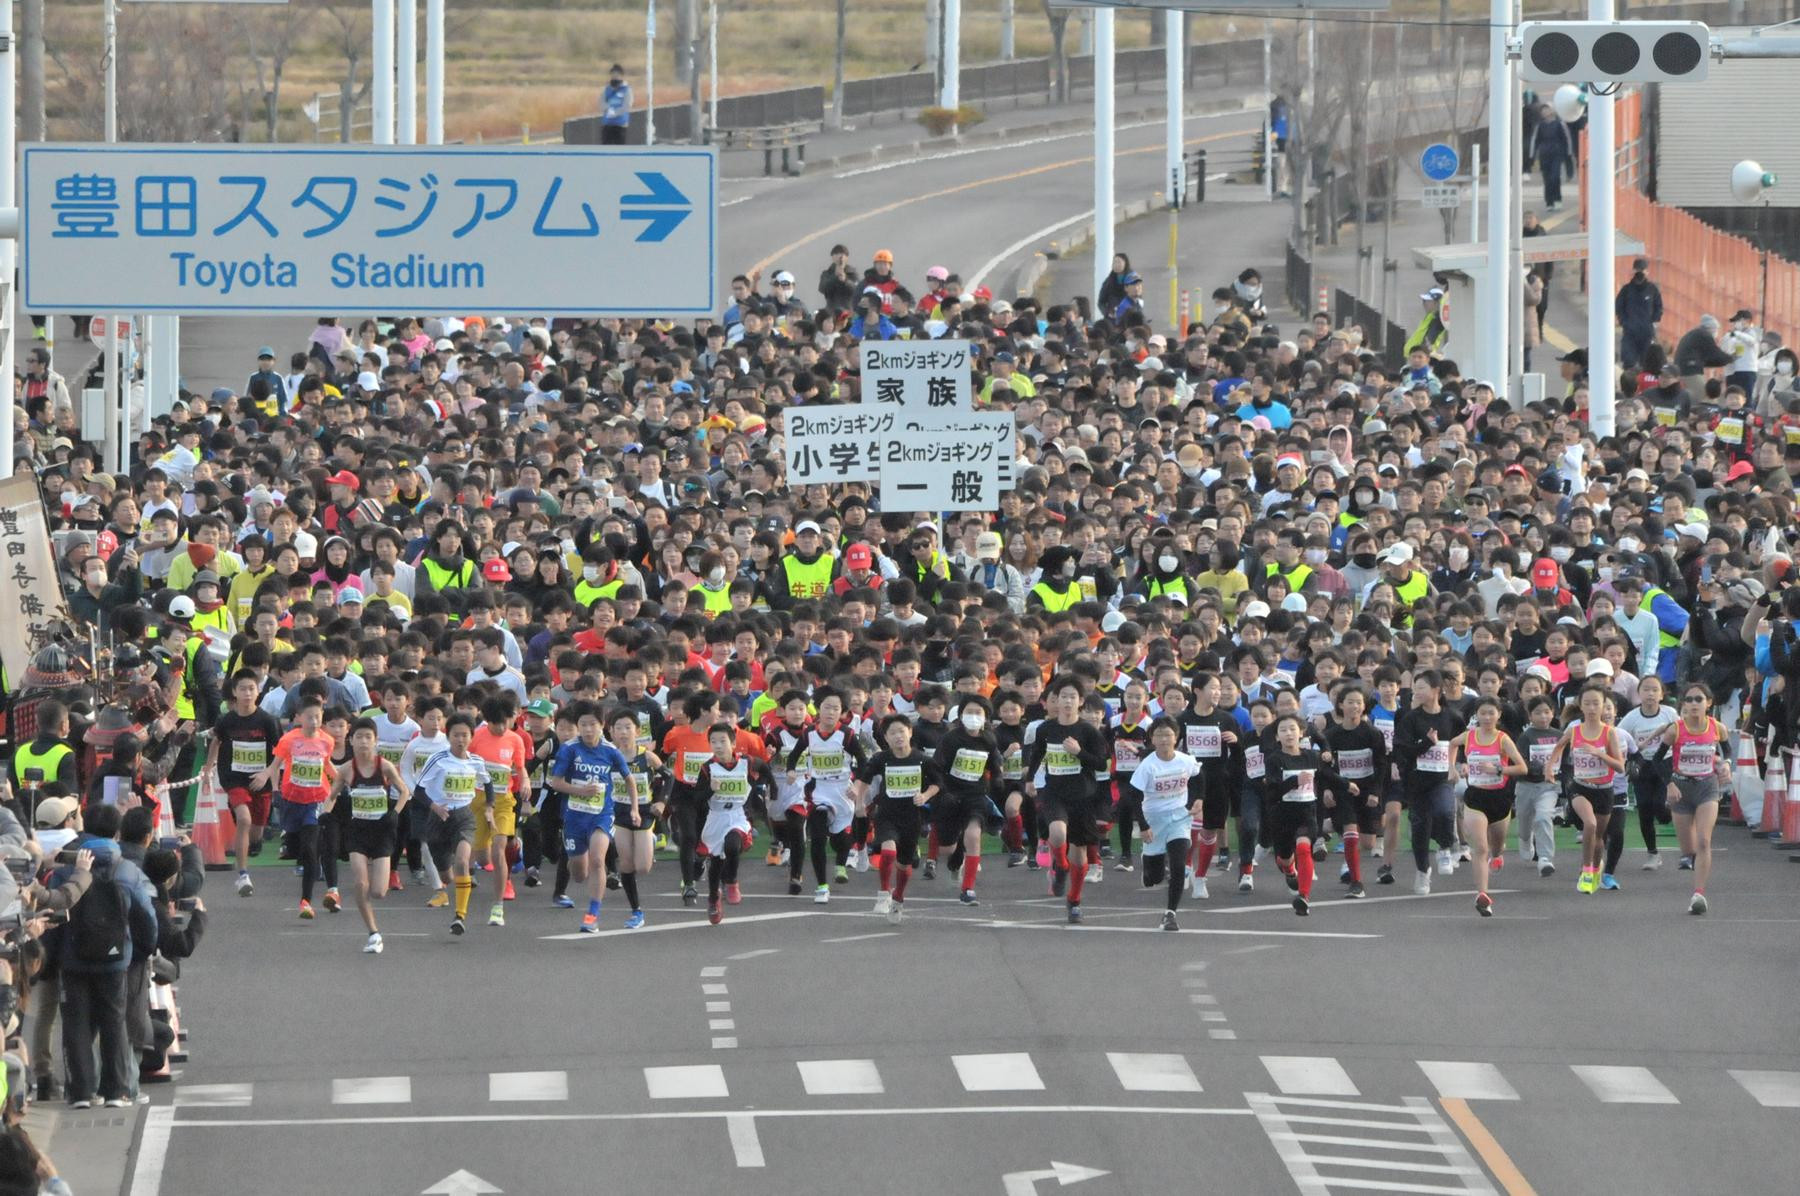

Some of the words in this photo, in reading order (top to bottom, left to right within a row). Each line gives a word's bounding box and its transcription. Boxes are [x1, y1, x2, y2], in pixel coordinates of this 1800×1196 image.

[51, 173, 600, 239] 豊田スタジアム
[170, 252, 298, 295] Toyota
[331, 252, 484, 289] Stadium
[867, 350, 966, 370] 2kmジョギング
[877, 376, 957, 407] 家族
[791, 412, 895, 437] 2kmジョギング
[887, 440, 994, 463] 2kmジョギング
[897, 470, 983, 504] 一般
[1187, 735, 1218, 746] 8568
[233, 750, 263, 761] 8105
[1246, 753, 1265, 767] 857
[292, 764, 321, 777] 8014
[955, 758, 982, 770] 8151
[720, 781, 742, 792] 001
[887, 775, 918, 787] 8148
[1155, 778, 1187, 792] 8578
[353, 799, 384, 810] 8238
